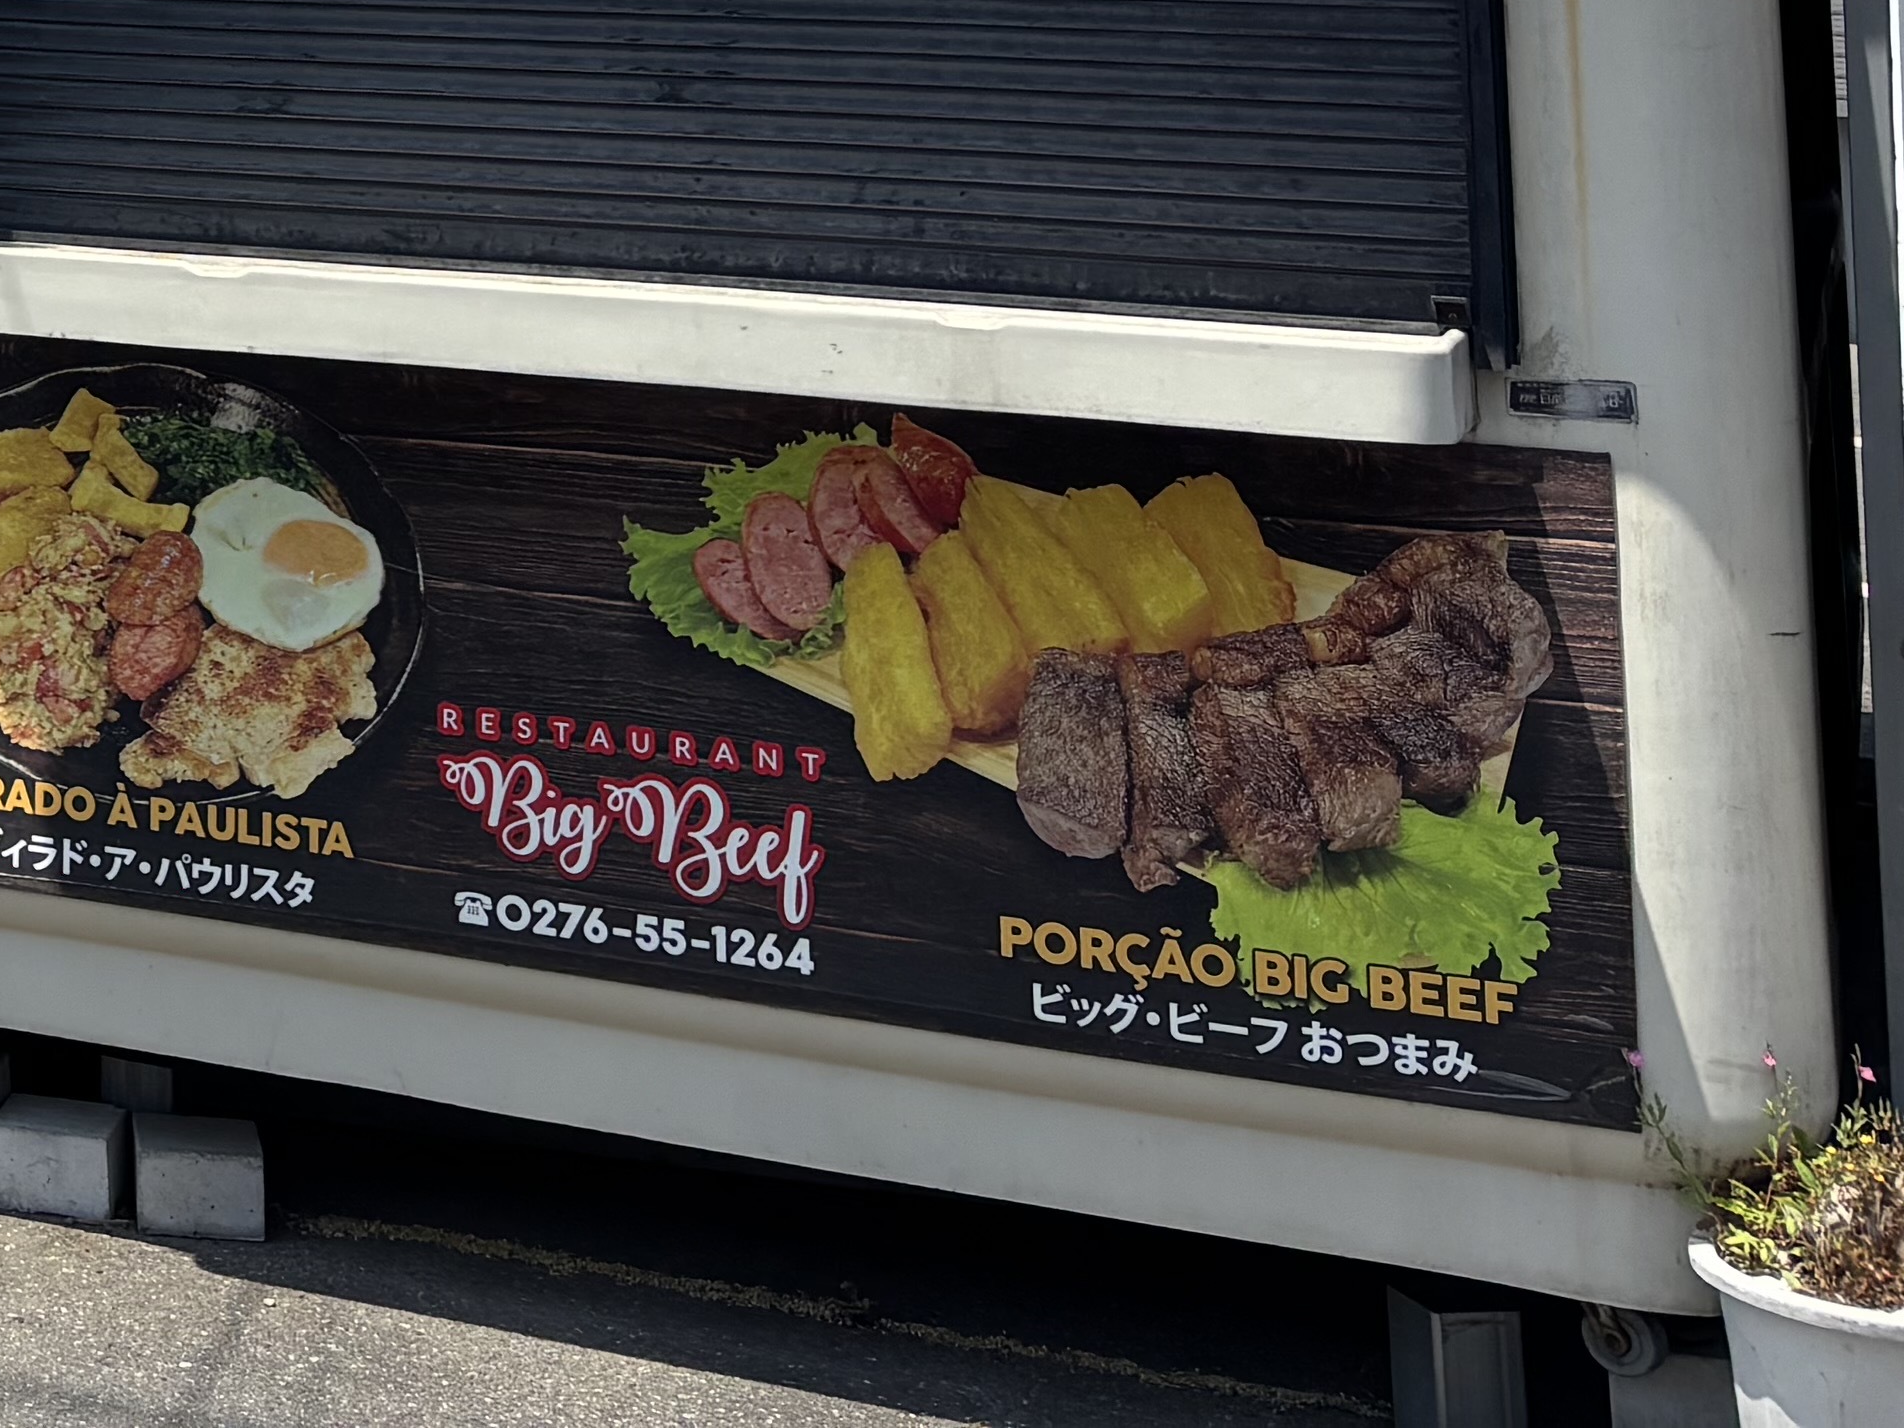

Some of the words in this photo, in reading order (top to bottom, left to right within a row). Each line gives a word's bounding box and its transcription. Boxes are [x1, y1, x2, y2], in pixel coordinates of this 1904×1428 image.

[441, 708, 821, 777] RESTAURANT
[107, 782, 139, 829] À
[149, 797, 355, 859] PAULISTA
[441, 755, 607, 875] Big
[602, 778, 820, 925] Beef
[495, 894, 815, 977] 0276-55-1264
[999, 915, 1237, 992] PORÇÃO
[1254, 950, 1350, 1004] BIG
[1369, 965, 1519, 1026] BEEF
[1031, 982, 1289, 1056] ビッグ・ビーフ
[1300, 1020, 1479, 1084] おつまみ
